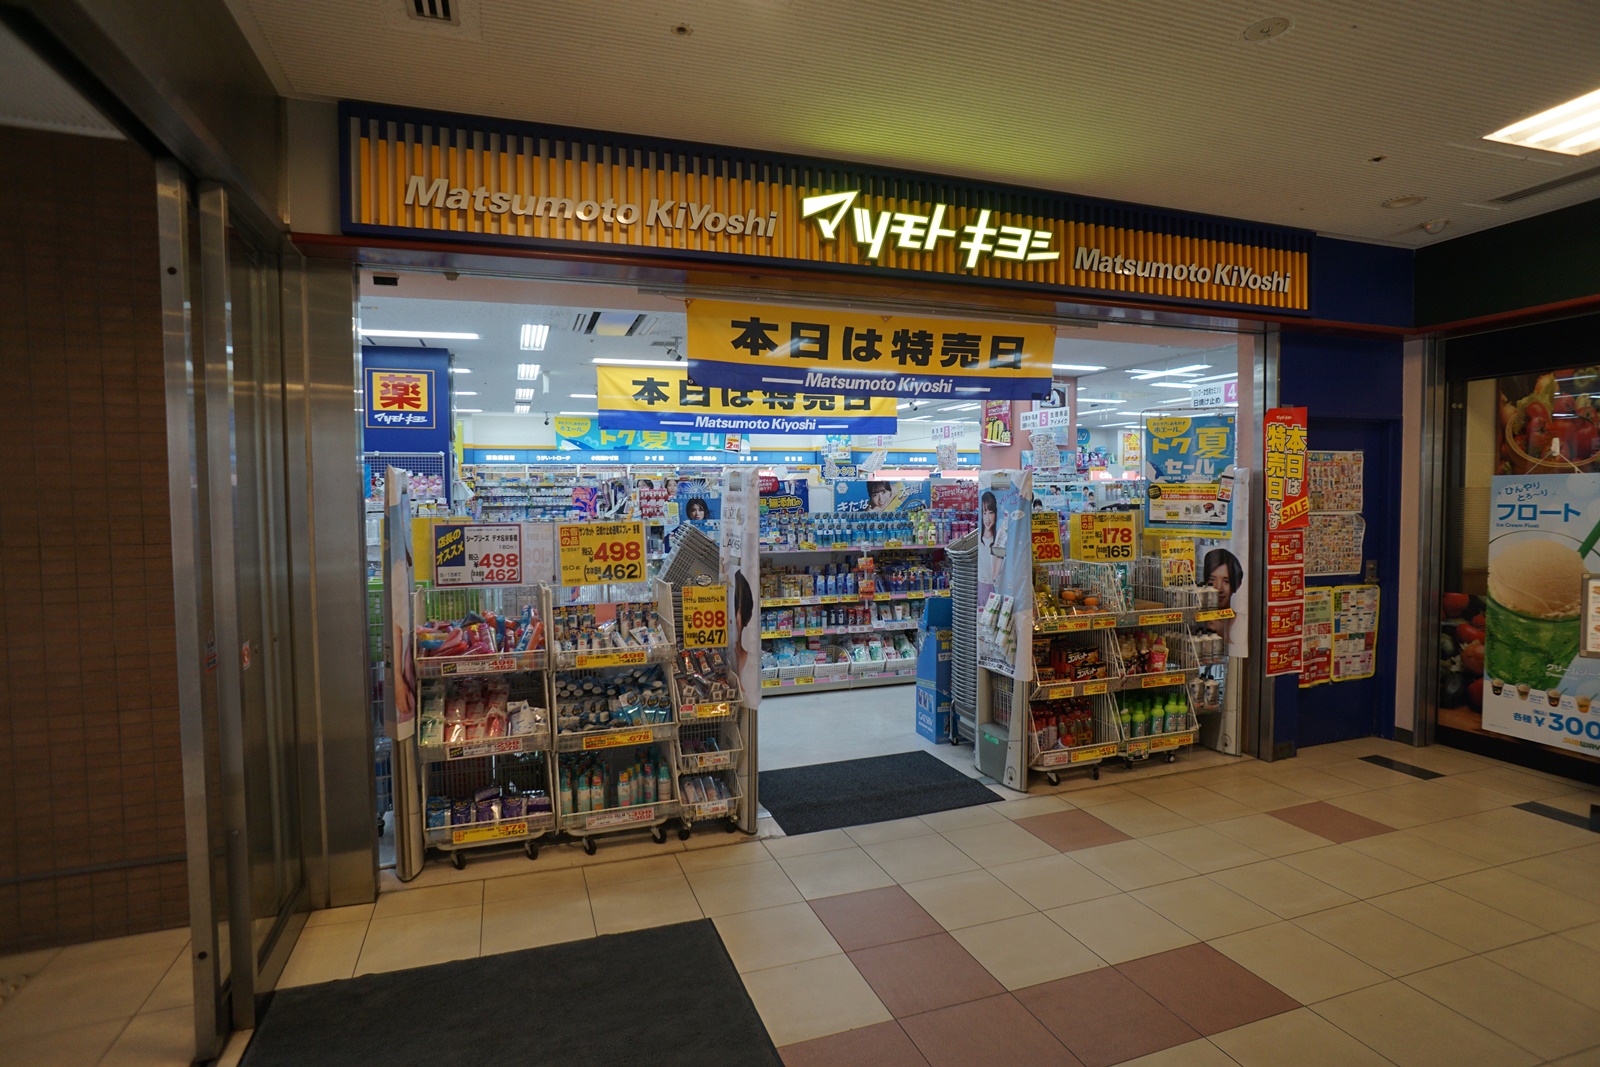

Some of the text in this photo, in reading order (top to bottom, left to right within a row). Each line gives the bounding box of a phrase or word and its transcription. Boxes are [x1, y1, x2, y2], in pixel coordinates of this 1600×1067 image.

[403, 174, 778, 238] Matsumoto KiYoshi
[801, 189, 1061, 270] マツモトキヨシ
[1074, 246, 1291, 294] Matsumoto KiYoshi
[730, 316, 1026, 371] 本日は特売日
[379, 374, 422, 410] 薬
[804, 372, 954, 394] Matsumoto Kiyoshi
[1227, 383, 1237, 400] 4
[374, 412, 428, 425] マツモトキヨシ
[694, 415, 817, 432] Matsumoto Kiyoshi
[1041, 413, 1047, 425] 5
[985, 419, 1012, 443] 10倍
[1152, 427, 1231, 459] トク夏
[1164, 458, 1215, 475] セール
[1285, 425, 1308, 496] 本日は
[1266, 423, 1287, 529] 特売日です
[1504, 481, 1540, 495] ひんやり
[1281, 498, 1309, 522] SALE
[1497, 503, 1581, 523] フロート
[436, 541, 465, 565] オススメ
[1513, 712, 1532, 724] 各種
[1562, 737, 1600, 751] SUBWAY
